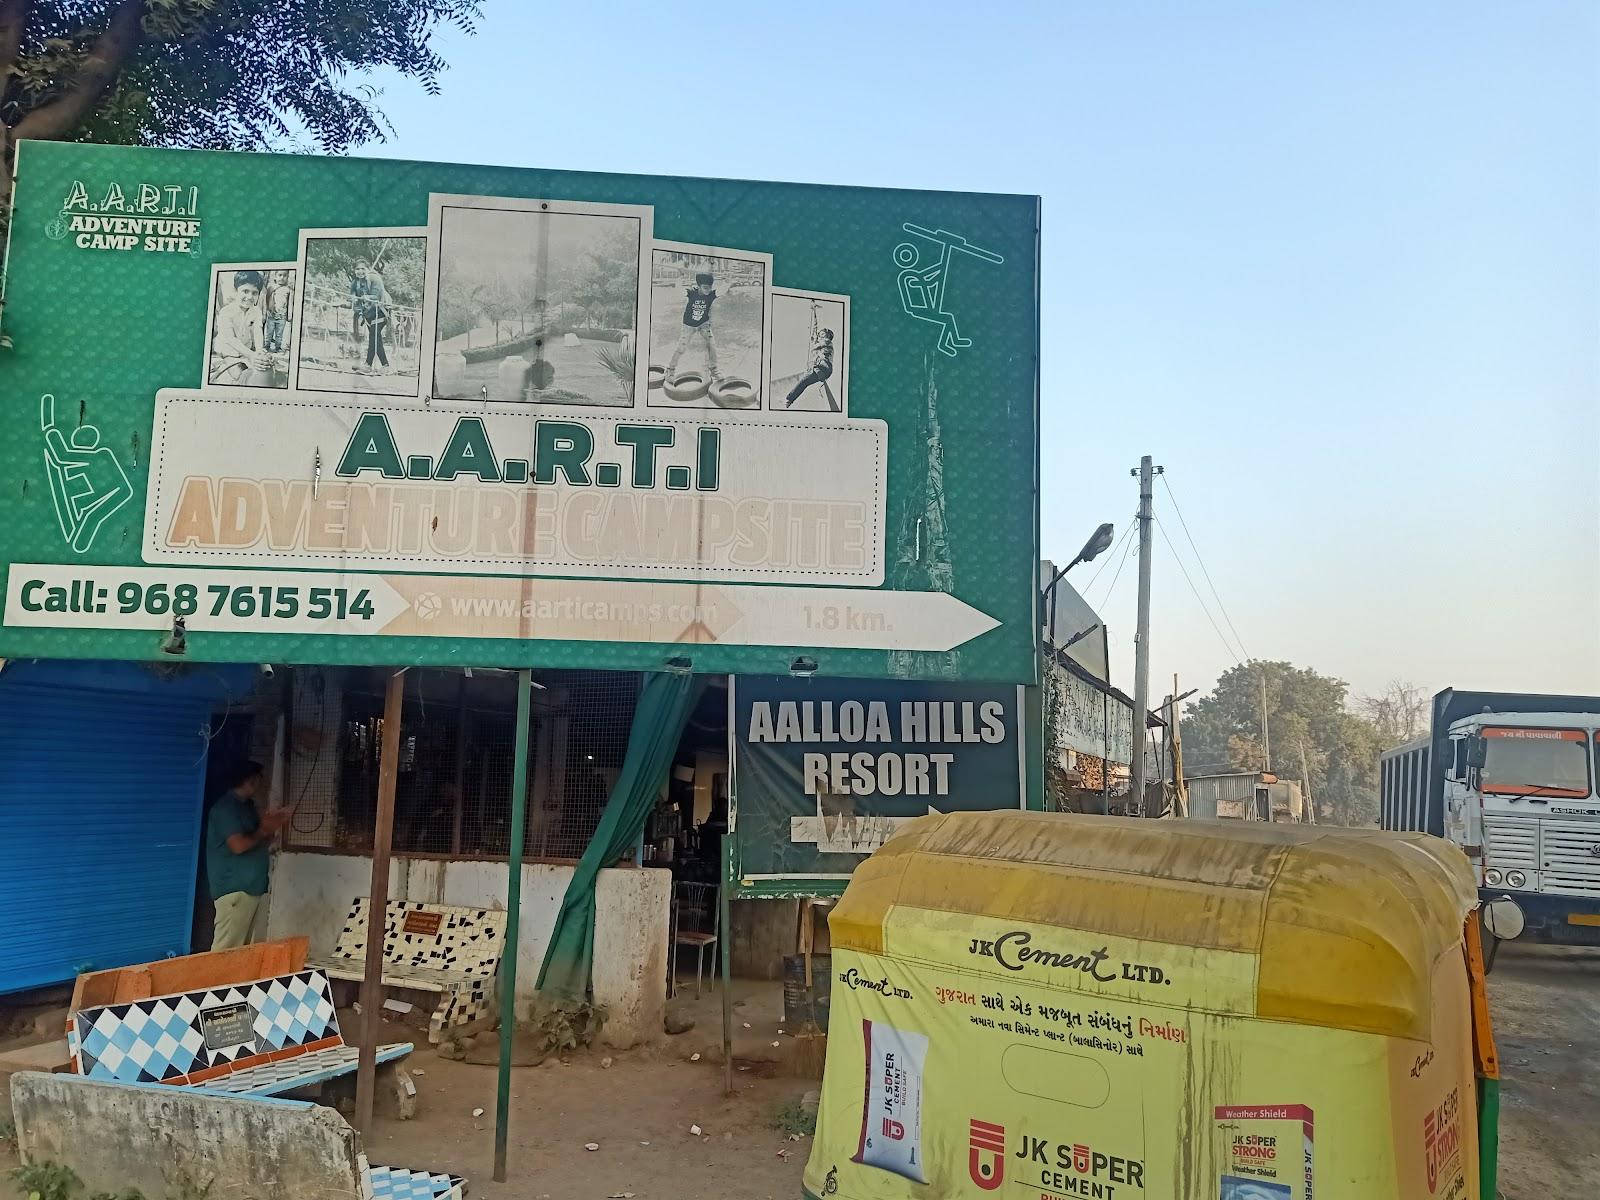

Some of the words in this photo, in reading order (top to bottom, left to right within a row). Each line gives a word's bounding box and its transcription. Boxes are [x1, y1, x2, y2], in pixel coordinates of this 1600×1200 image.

[69, 215, 200, 236] ADVENTURE
[76, 234, 139, 250] CAMP
[143, 237, 192, 253] SITE
[335, 412, 721, 491] A.A.R.T.I
[20, 580, 108, 614] Call:
[117, 582, 198, 616] 968
[207, 585, 299, 619] 7615
[307, 588, 375, 621] 514
[450, 596, 718, 625] www.aarticamps.com
[803, 605, 840, 630] 1.8
[845, 606, 894, 633] km.
[749, 701, 892, 743] AALLOA
[901, 701, 1006, 744] HILLS
[803, 752, 954, 796] RESORT
[1552, 807, 1589, 815] ASHOK
[1122, 963, 1171, 986] LTD.
[893, 987, 913, 1000] LTD.
[935, 986, 976, 1005] ગુજરાત
[981, 993, 1005, 1011] સાથે
[1010, 993, 1033, 1017] એક
[1038, 1005, 1082, 1029] મજબૂત
[1087, 1010, 1134, 1039] સંબંધનું
[1139, 1017, 1187, 1044] નિર્માણ
[970, 1015, 995, 1029] અમારા
[998, 1022, 1012, 1032] નવા
[1015, 1021, 1040, 1037] સિમેન્ટ
[1043, 1029, 1065, 1042] પ્લાન્ટ
[1126, 1043, 1144, 1057] સાથે
[884, 1053, 895, 1095] SUPER
[884, 1096, 893, 1115] JK
[1226, 1110, 1257, 1118] Weather
[1260, 1109, 1287, 1118] Shield
[1232, 1135, 1244, 1145] JK
[1246, 1135, 1276, 1147] SUPER
[1232, 1146, 1276, 1159] STRONG
[1016, 1135, 1048, 1165] JK
[1057, 1143, 1144, 1189] SUPER
[1304, 1149, 1312, 1164] JK
[1232, 1165, 1257, 1175] Weather
[1257, 1168, 1277, 1178] Shield
[1042, 1170, 1115, 1200] CEMENT
